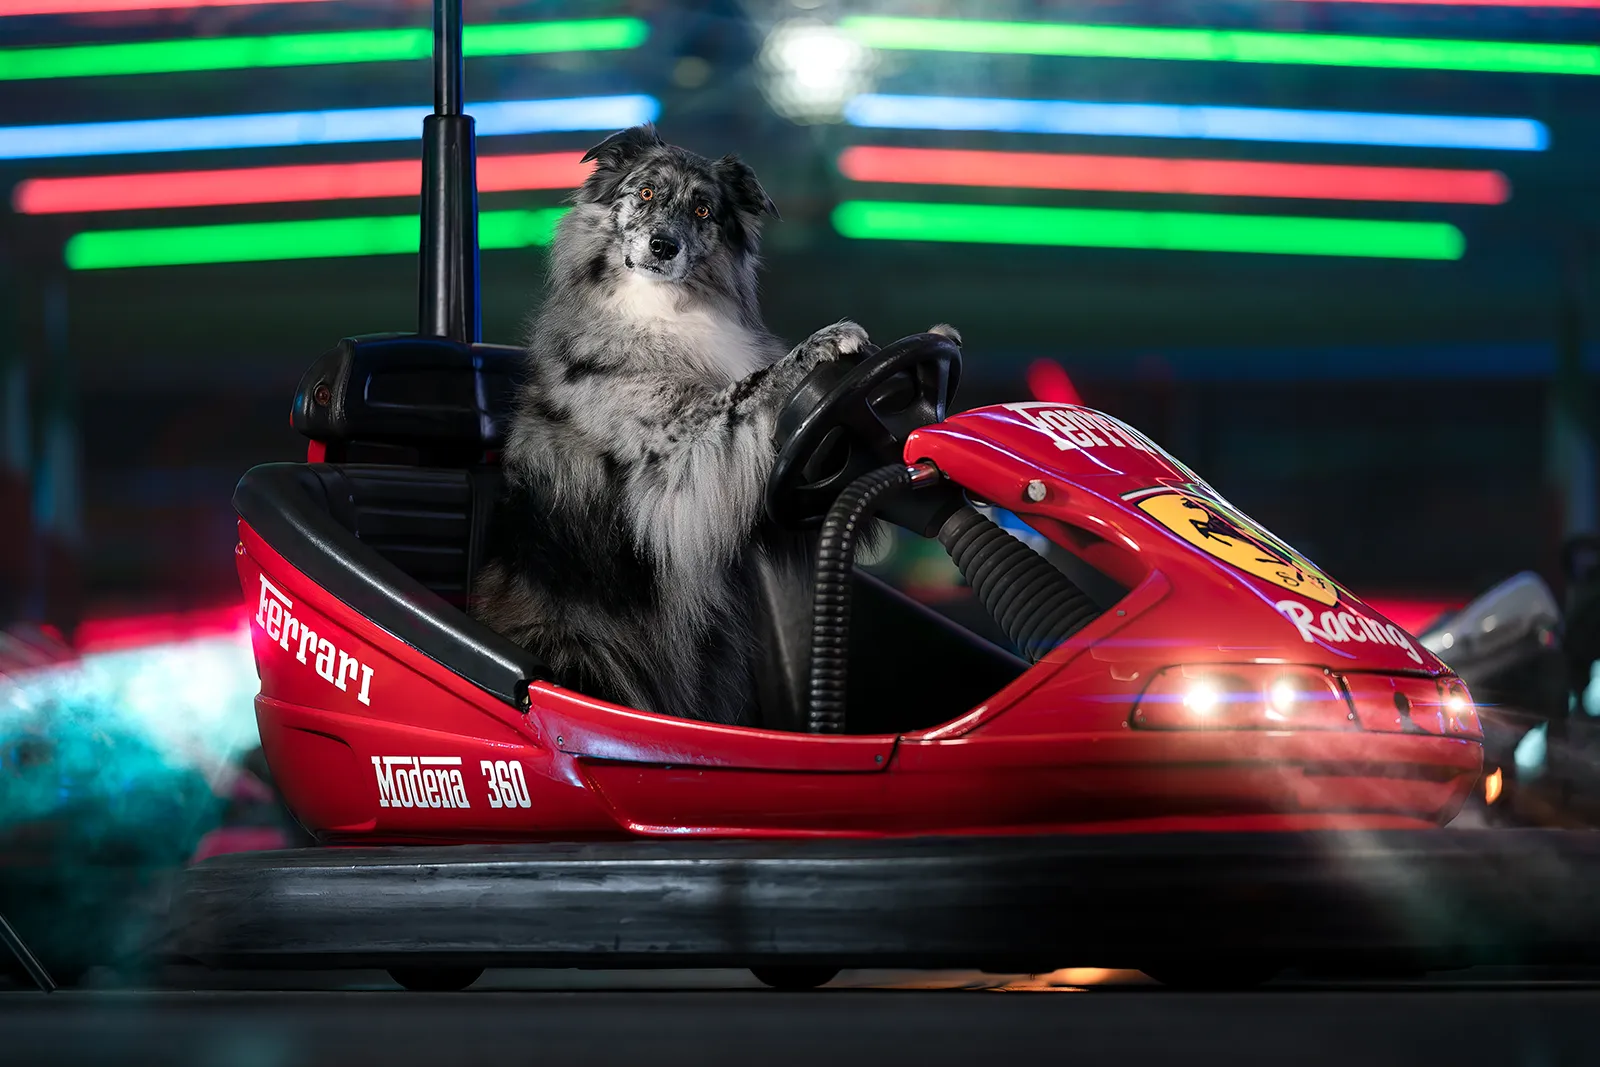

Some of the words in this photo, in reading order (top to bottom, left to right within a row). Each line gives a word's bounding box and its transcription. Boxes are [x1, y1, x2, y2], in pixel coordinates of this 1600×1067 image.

[255, 573, 375, 706] Ferrari
[1276, 600, 1424, 665] Racing
[371, 756, 471, 809] Modena
[480, 760, 532, 809] 360
